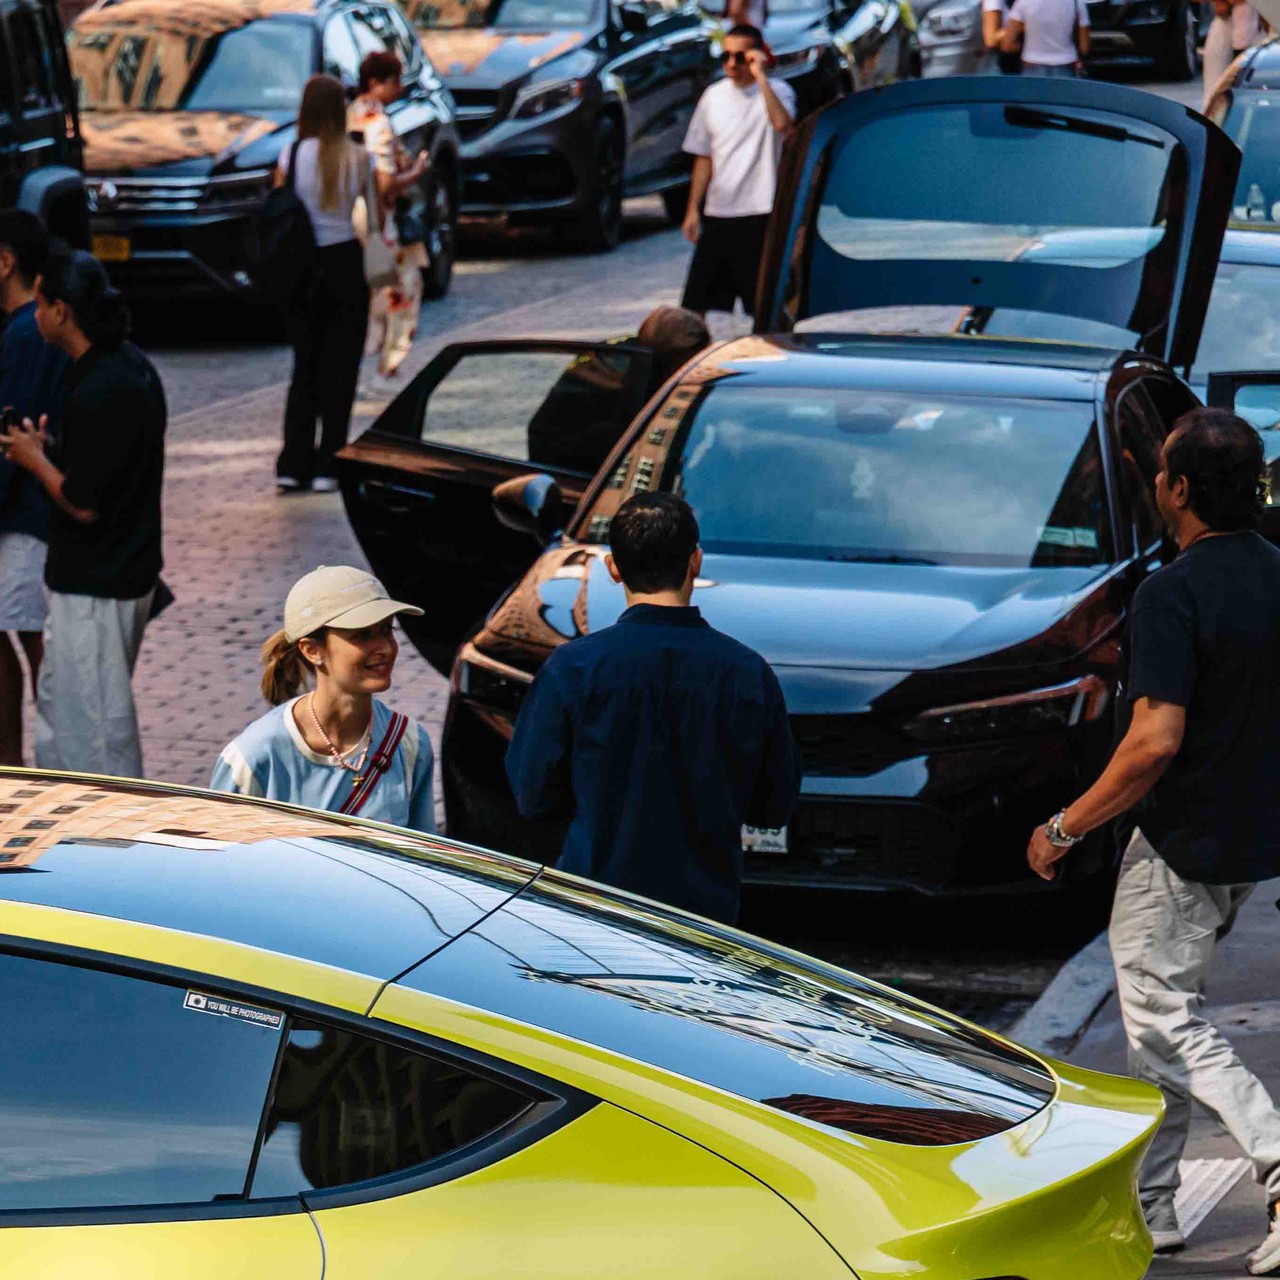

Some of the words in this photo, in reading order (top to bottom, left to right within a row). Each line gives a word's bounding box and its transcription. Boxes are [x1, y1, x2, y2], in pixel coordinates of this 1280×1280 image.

[207, 1001, 219, 1010] YOU
[219, 1003, 230, 1013] WILL
[231, 1006, 239, 1015] BE
[239, 1008, 280, 1024] PHOTOGRAPHED
